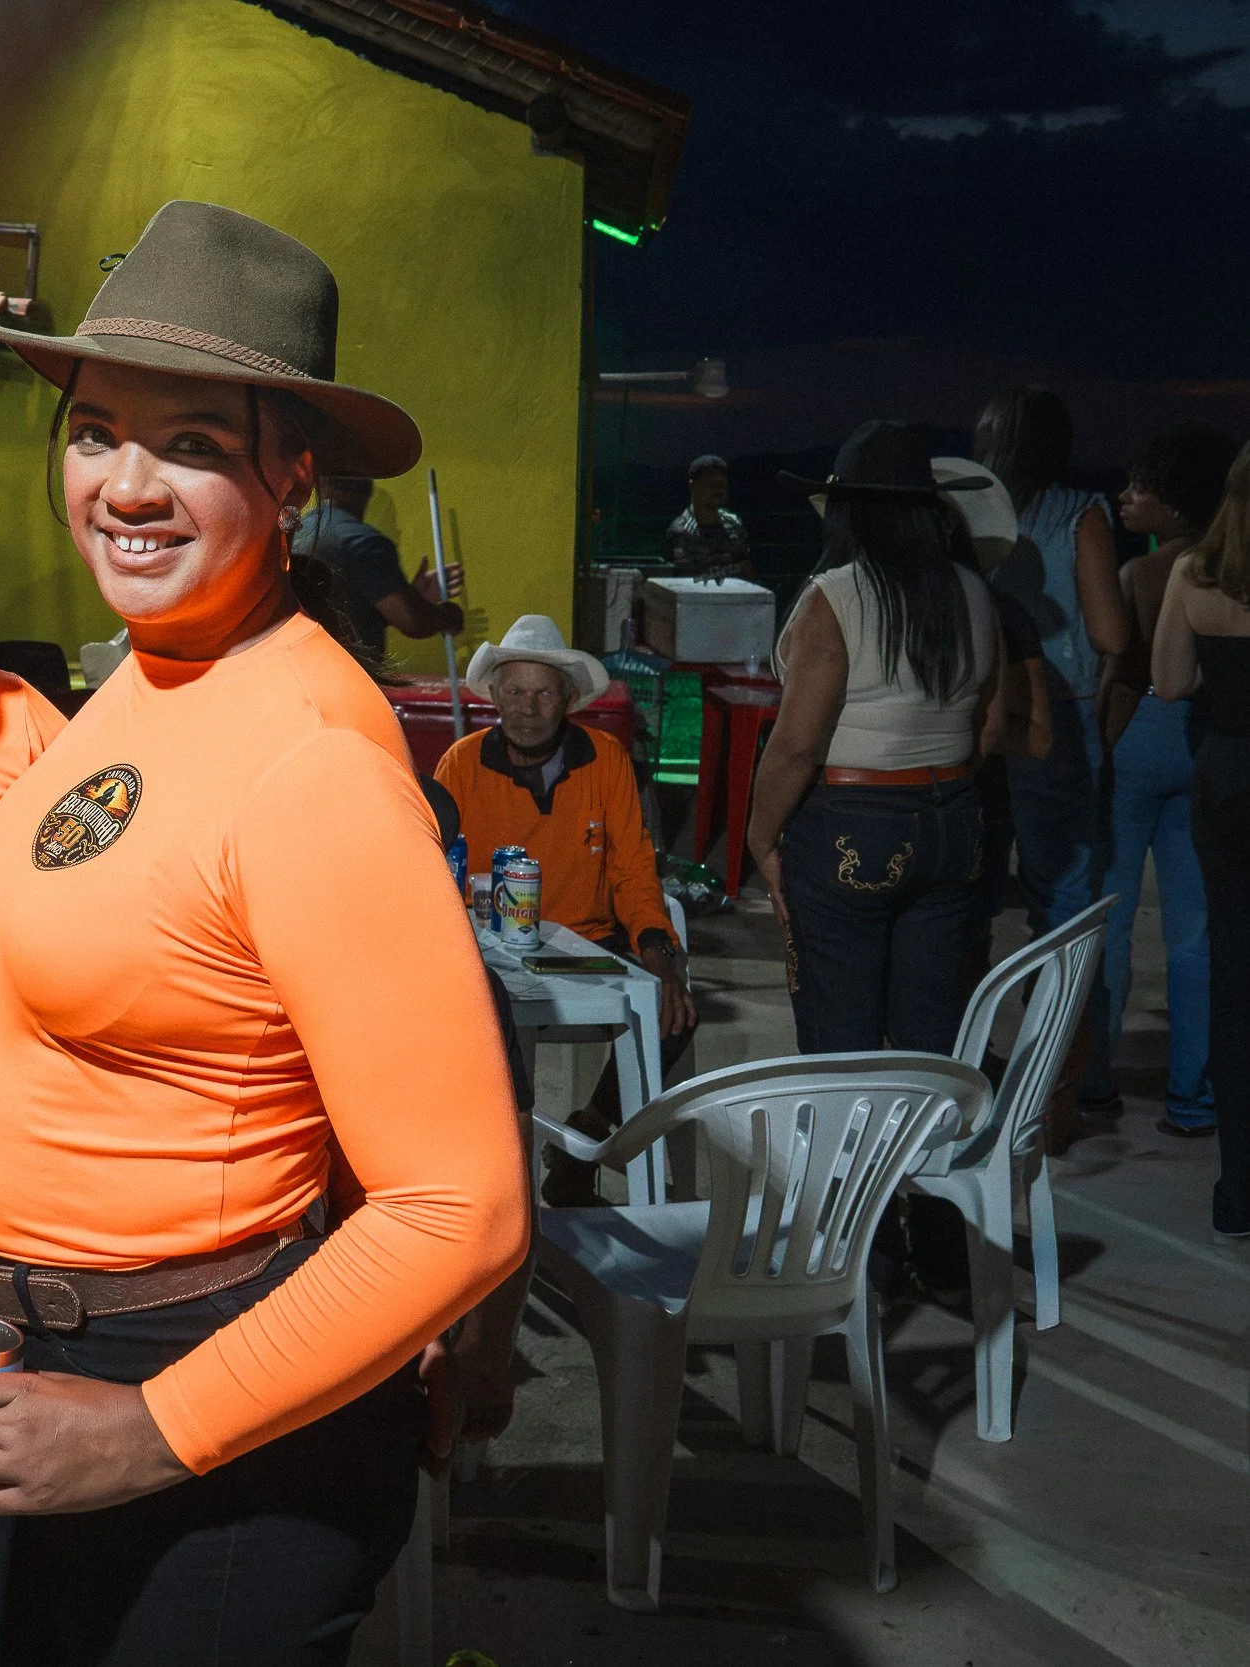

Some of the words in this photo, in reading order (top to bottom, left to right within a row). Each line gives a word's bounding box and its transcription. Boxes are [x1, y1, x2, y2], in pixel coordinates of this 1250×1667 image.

[105, 770, 136, 795] CAVALGADA
[53, 818, 86, 850] 50
[54, 793, 120, 846] BRANQUINHO
